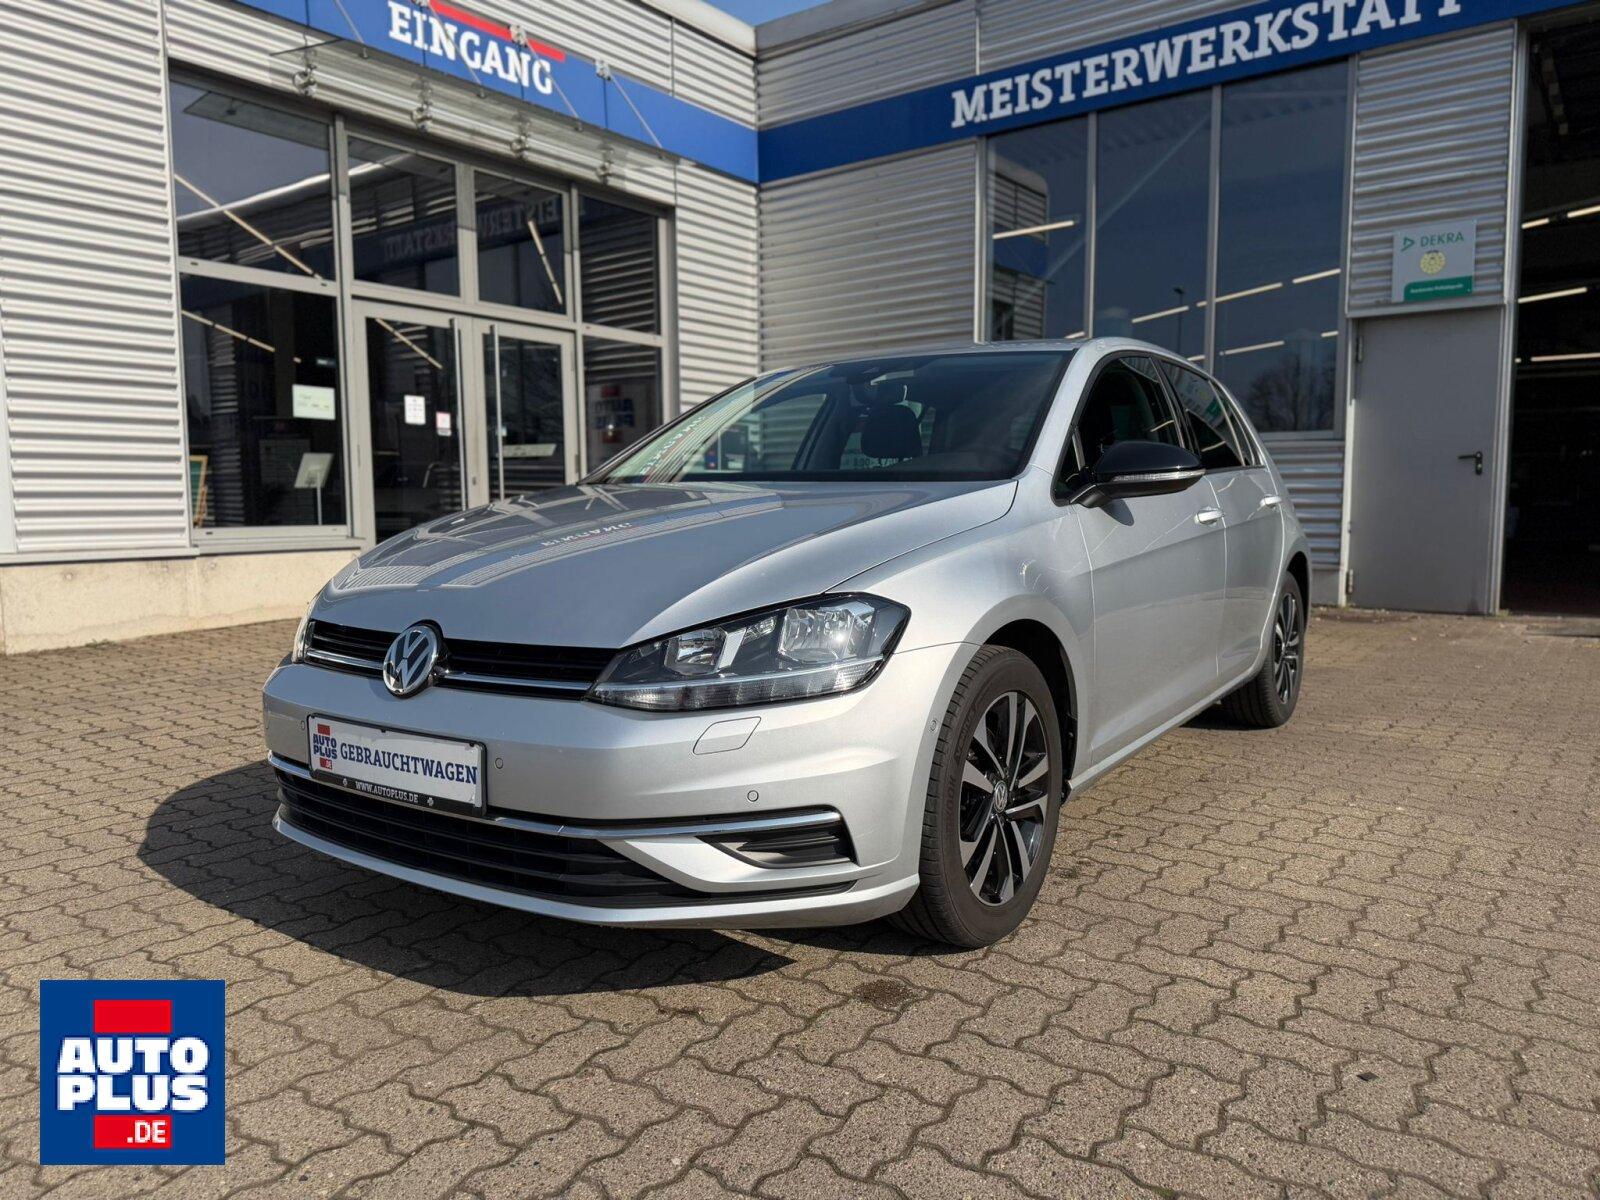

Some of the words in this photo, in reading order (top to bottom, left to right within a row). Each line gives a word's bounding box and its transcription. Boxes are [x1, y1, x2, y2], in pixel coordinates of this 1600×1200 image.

[388, 3, 553, 95] EINGANG
[1420, 232, 1465, 248] DEKRA
[313, 733, 337, 748] AUTO
[313, 745, 338, 759] PLUS
[341, 743, 478, 784] GEBRAUCHTWAGEN
[355, 781, 419, 803] WWW.AUTOPLUS.DE
